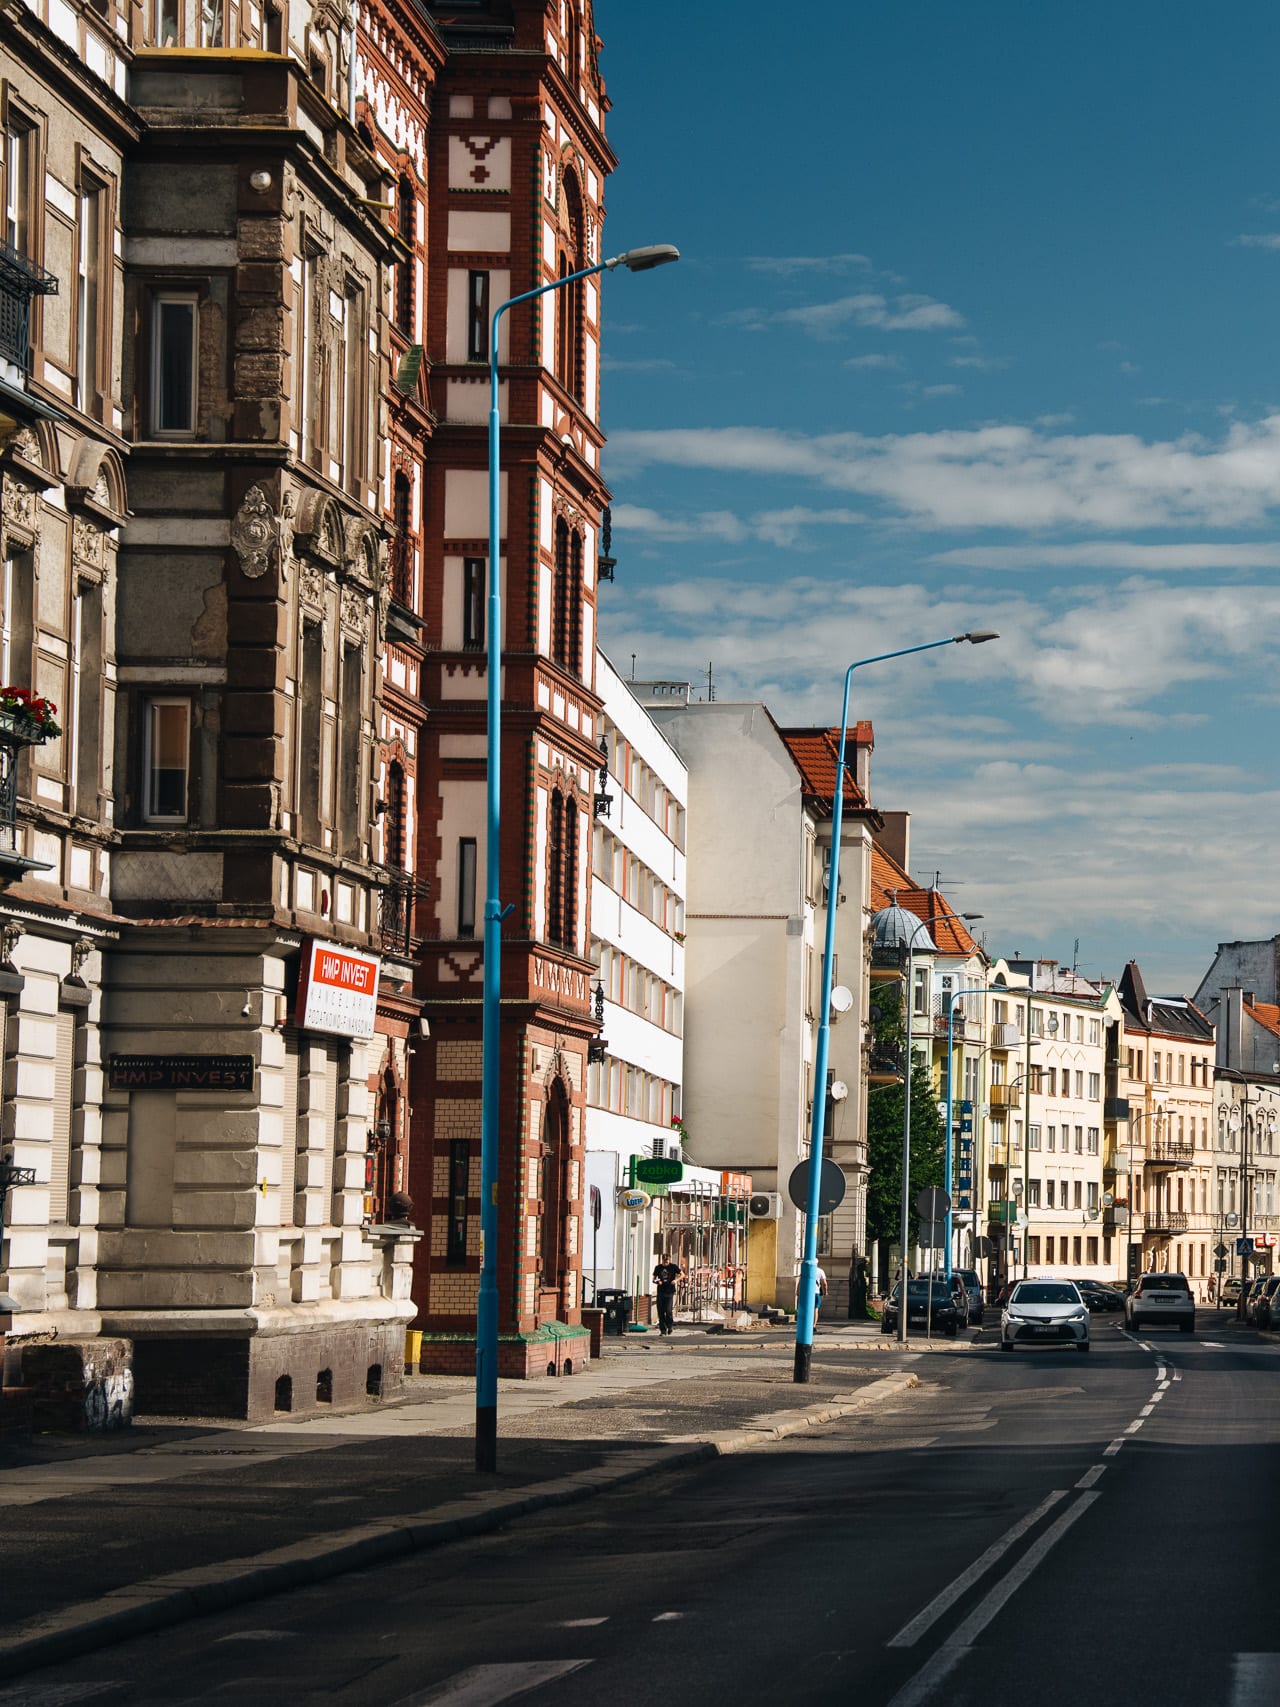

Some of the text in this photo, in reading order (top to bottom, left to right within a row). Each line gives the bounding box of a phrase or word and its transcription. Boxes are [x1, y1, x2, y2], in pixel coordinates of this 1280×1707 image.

[321, 955, 340, 980] HMP
[340, 961, 370, 988] INVEST
[113, 1071, 249, 1084] HMP INVEST
